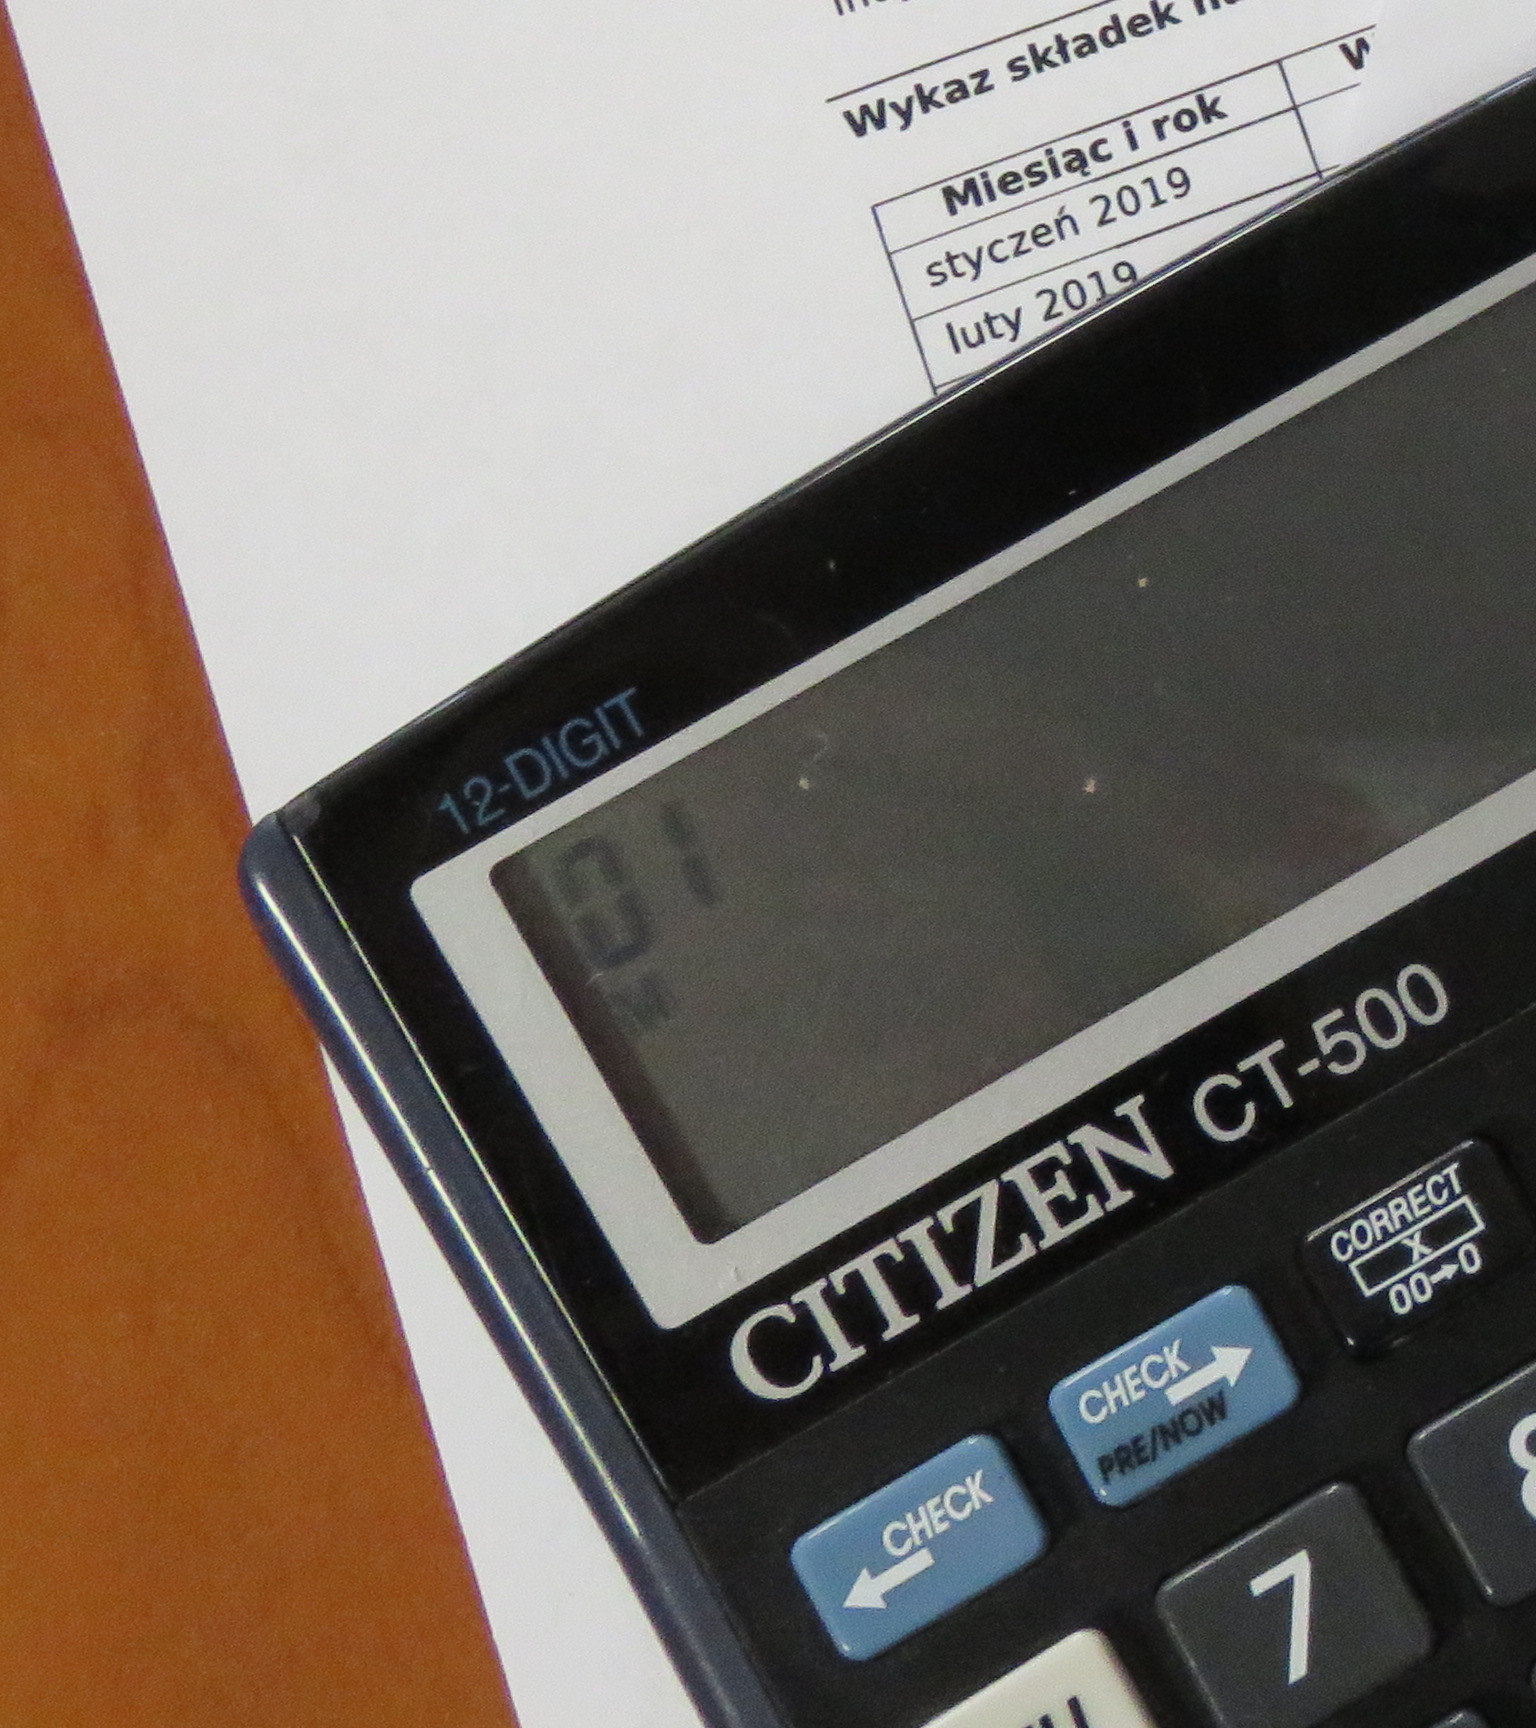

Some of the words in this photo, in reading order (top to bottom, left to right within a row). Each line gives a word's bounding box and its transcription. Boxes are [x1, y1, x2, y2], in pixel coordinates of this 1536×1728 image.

[843, 69, 994, 137] Wykaz
[1007, 0, 1181, 82] składek
[942, 138, 1112, 216] Miesiąc
[1122, 120, 1139, 151] i
[1152, 94, 1228, 141] rok
[927, 206, 1079, 287] styczeń
[1090, 167, 1190, 227] 2019
[946, 307, 1021, 350] luty
[437, 687, 648, 835] 12-DIGIT
[729, 1094, 1176, 1404] CITIZEN
[1192, 962, 1451, 1142] CT-500
[1330, 1162, 1466, 1263] CORRECT
[1078, 1339, 1190, 1425] CHECK
[1099, 1392, 1227, 1485] PRE/NOW
[881, 1469, 994, 1557] CHECK
[1250, 1550, 1311, 1685] 7
